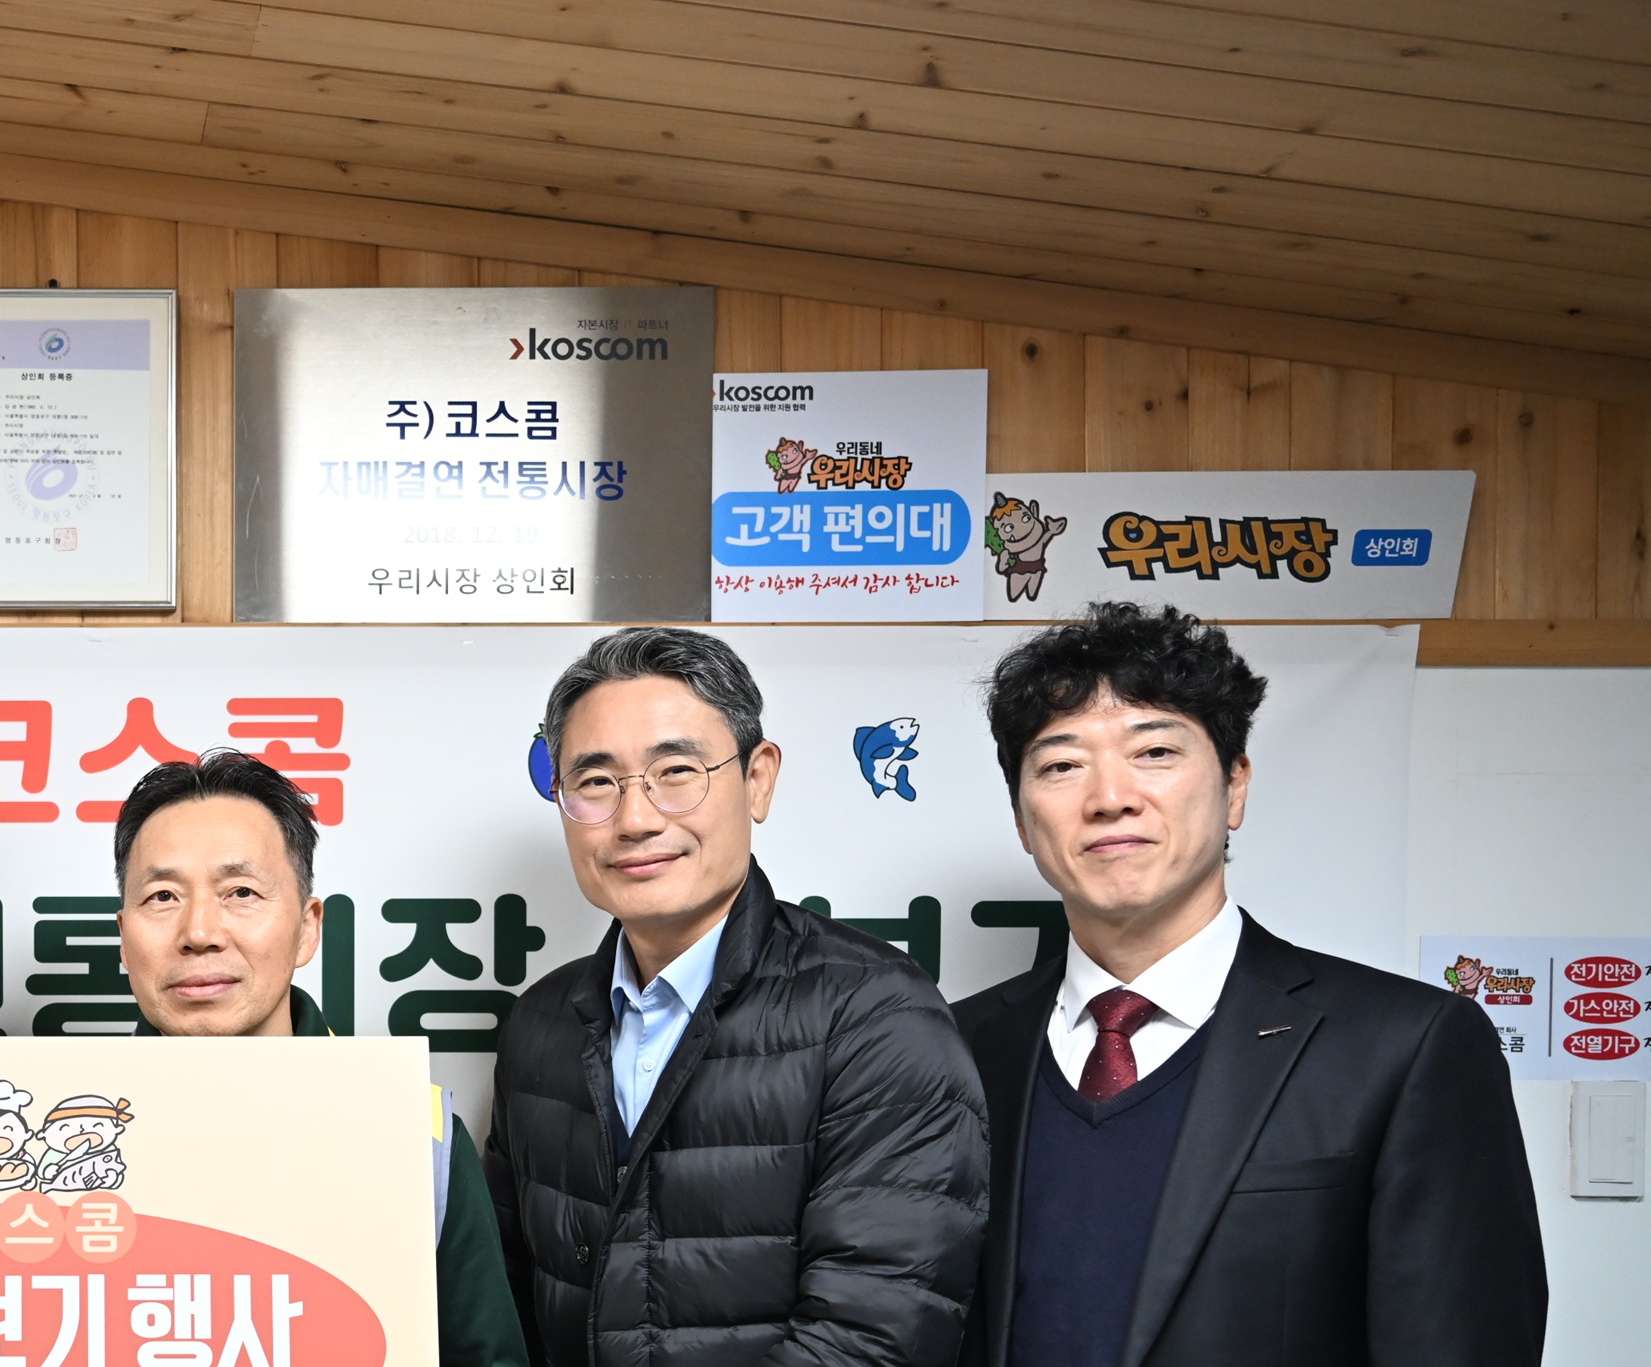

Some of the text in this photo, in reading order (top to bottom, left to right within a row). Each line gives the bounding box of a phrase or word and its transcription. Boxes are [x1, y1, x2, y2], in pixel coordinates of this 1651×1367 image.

[578, 319, 619, 331] 자본시장
[637, 319, 668, 331] 파트너
[529, 328, 668, 361] koscom
[21, 373, 73, 381] 상인회 등록증
[719, 380, 814, 402] koscom
[713, 403, 806, 412] 우리시장 발전을 위한 지원 협력
[446, 400, 560, 440] 코스콤
[836, 441, 883, 456] 우리동네
[317, 460, 627, 501] 자매결연 전통시장
[808, 454, 912, 490] 우리시장
[725, 502, 952, 552] 고객 편의대
[1098, 511, 1420, 584] 우리시장 상인회
[368, 567, 575, 595] 우리시장 상인회
[715, 575, 754, 594] 항상
[759, 574, 805, 595] 이용해
[809, 573, 858, 594] 주셔서
[1495, 967, 1519, 976] 우리동네
[1570, 963, 1636, 982] 전기안전
[1484, 977, 1535, 994] 우리시장
[1497, 996, 1520, 1004] 상인회
[1569, 999, 1635, 1018] 가스안전
[1570, 1035, 1636, 1054] 전열기구
